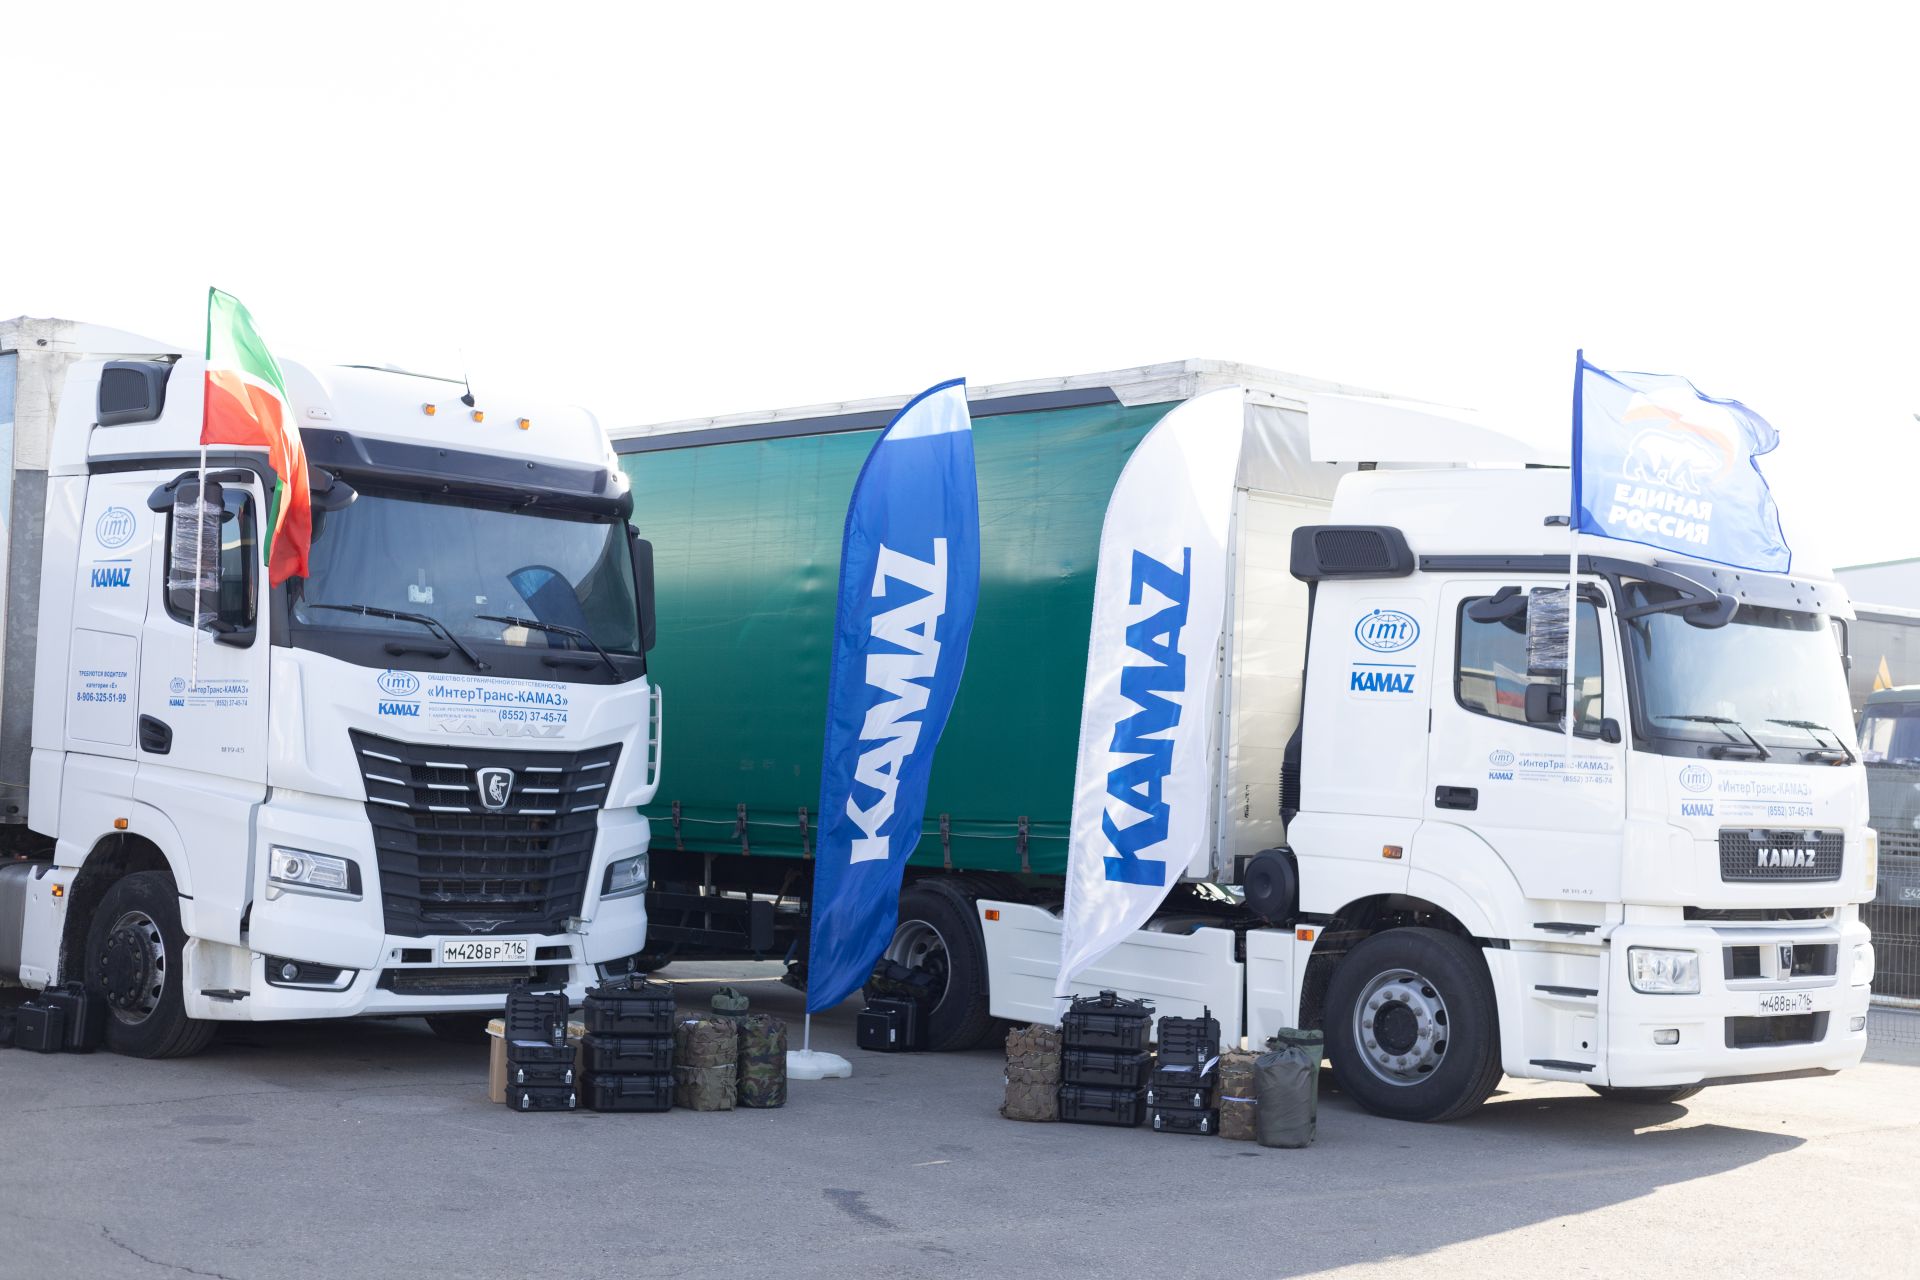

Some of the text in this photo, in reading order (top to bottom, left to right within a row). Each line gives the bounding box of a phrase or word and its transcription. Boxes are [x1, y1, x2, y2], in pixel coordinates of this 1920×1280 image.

[1613, 483, 1713, 521] ЕДИНАЯ
[1608, 505, 1710, 544] РОССИЯ
[91, 568, 131, 588] KAMAZ
[1368, 620, 1408, 640] imt
[1351, 671, 1415, 693] KAMAZ
[76, 692, 127, 702] 8-906-325-51-99
[427, 685, 568, 706] «ИнтерТранс-КАМАЗ»
[846, 538, 947, 864] KAMAZ
[379, 703, 420, 716] KAMAZ
[498, 710, 567, 723] (8552) 37-45-74
[1102, 547, 1191, 886] KAMAZ
[1488, 771, 1513, 780] KAMAZ
[1681, 803, 1714, 816] KAMAZ
[1767, 805, 1787, 817] (8552)
[1788, 806, 1814, 817] 37-45-74
[1757, 848, 1816, 868] KAMAZ
[504, 942, 523, 955] 716
